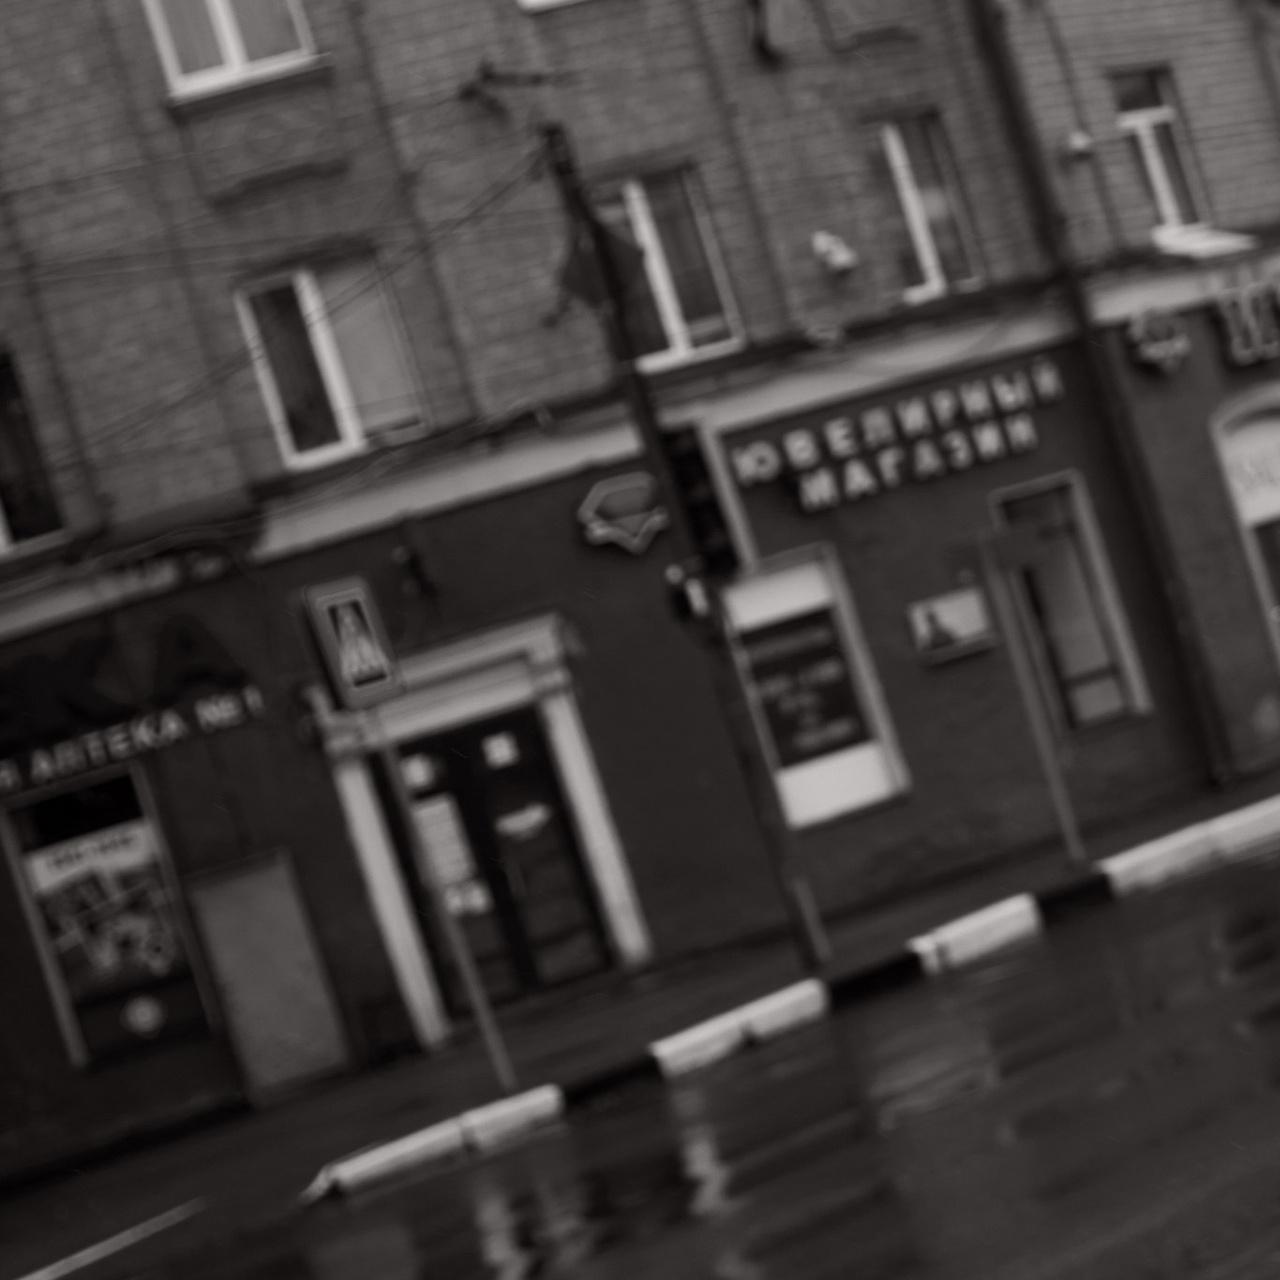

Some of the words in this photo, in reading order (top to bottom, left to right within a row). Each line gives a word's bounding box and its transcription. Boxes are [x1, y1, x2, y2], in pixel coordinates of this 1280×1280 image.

[732, 357, 1064, 487] ЮВЕЛИРНЫЙ
[800, 413, 1039, 511] МАГАЗИН
[30, 708, 188, 786] АПТЕКА
